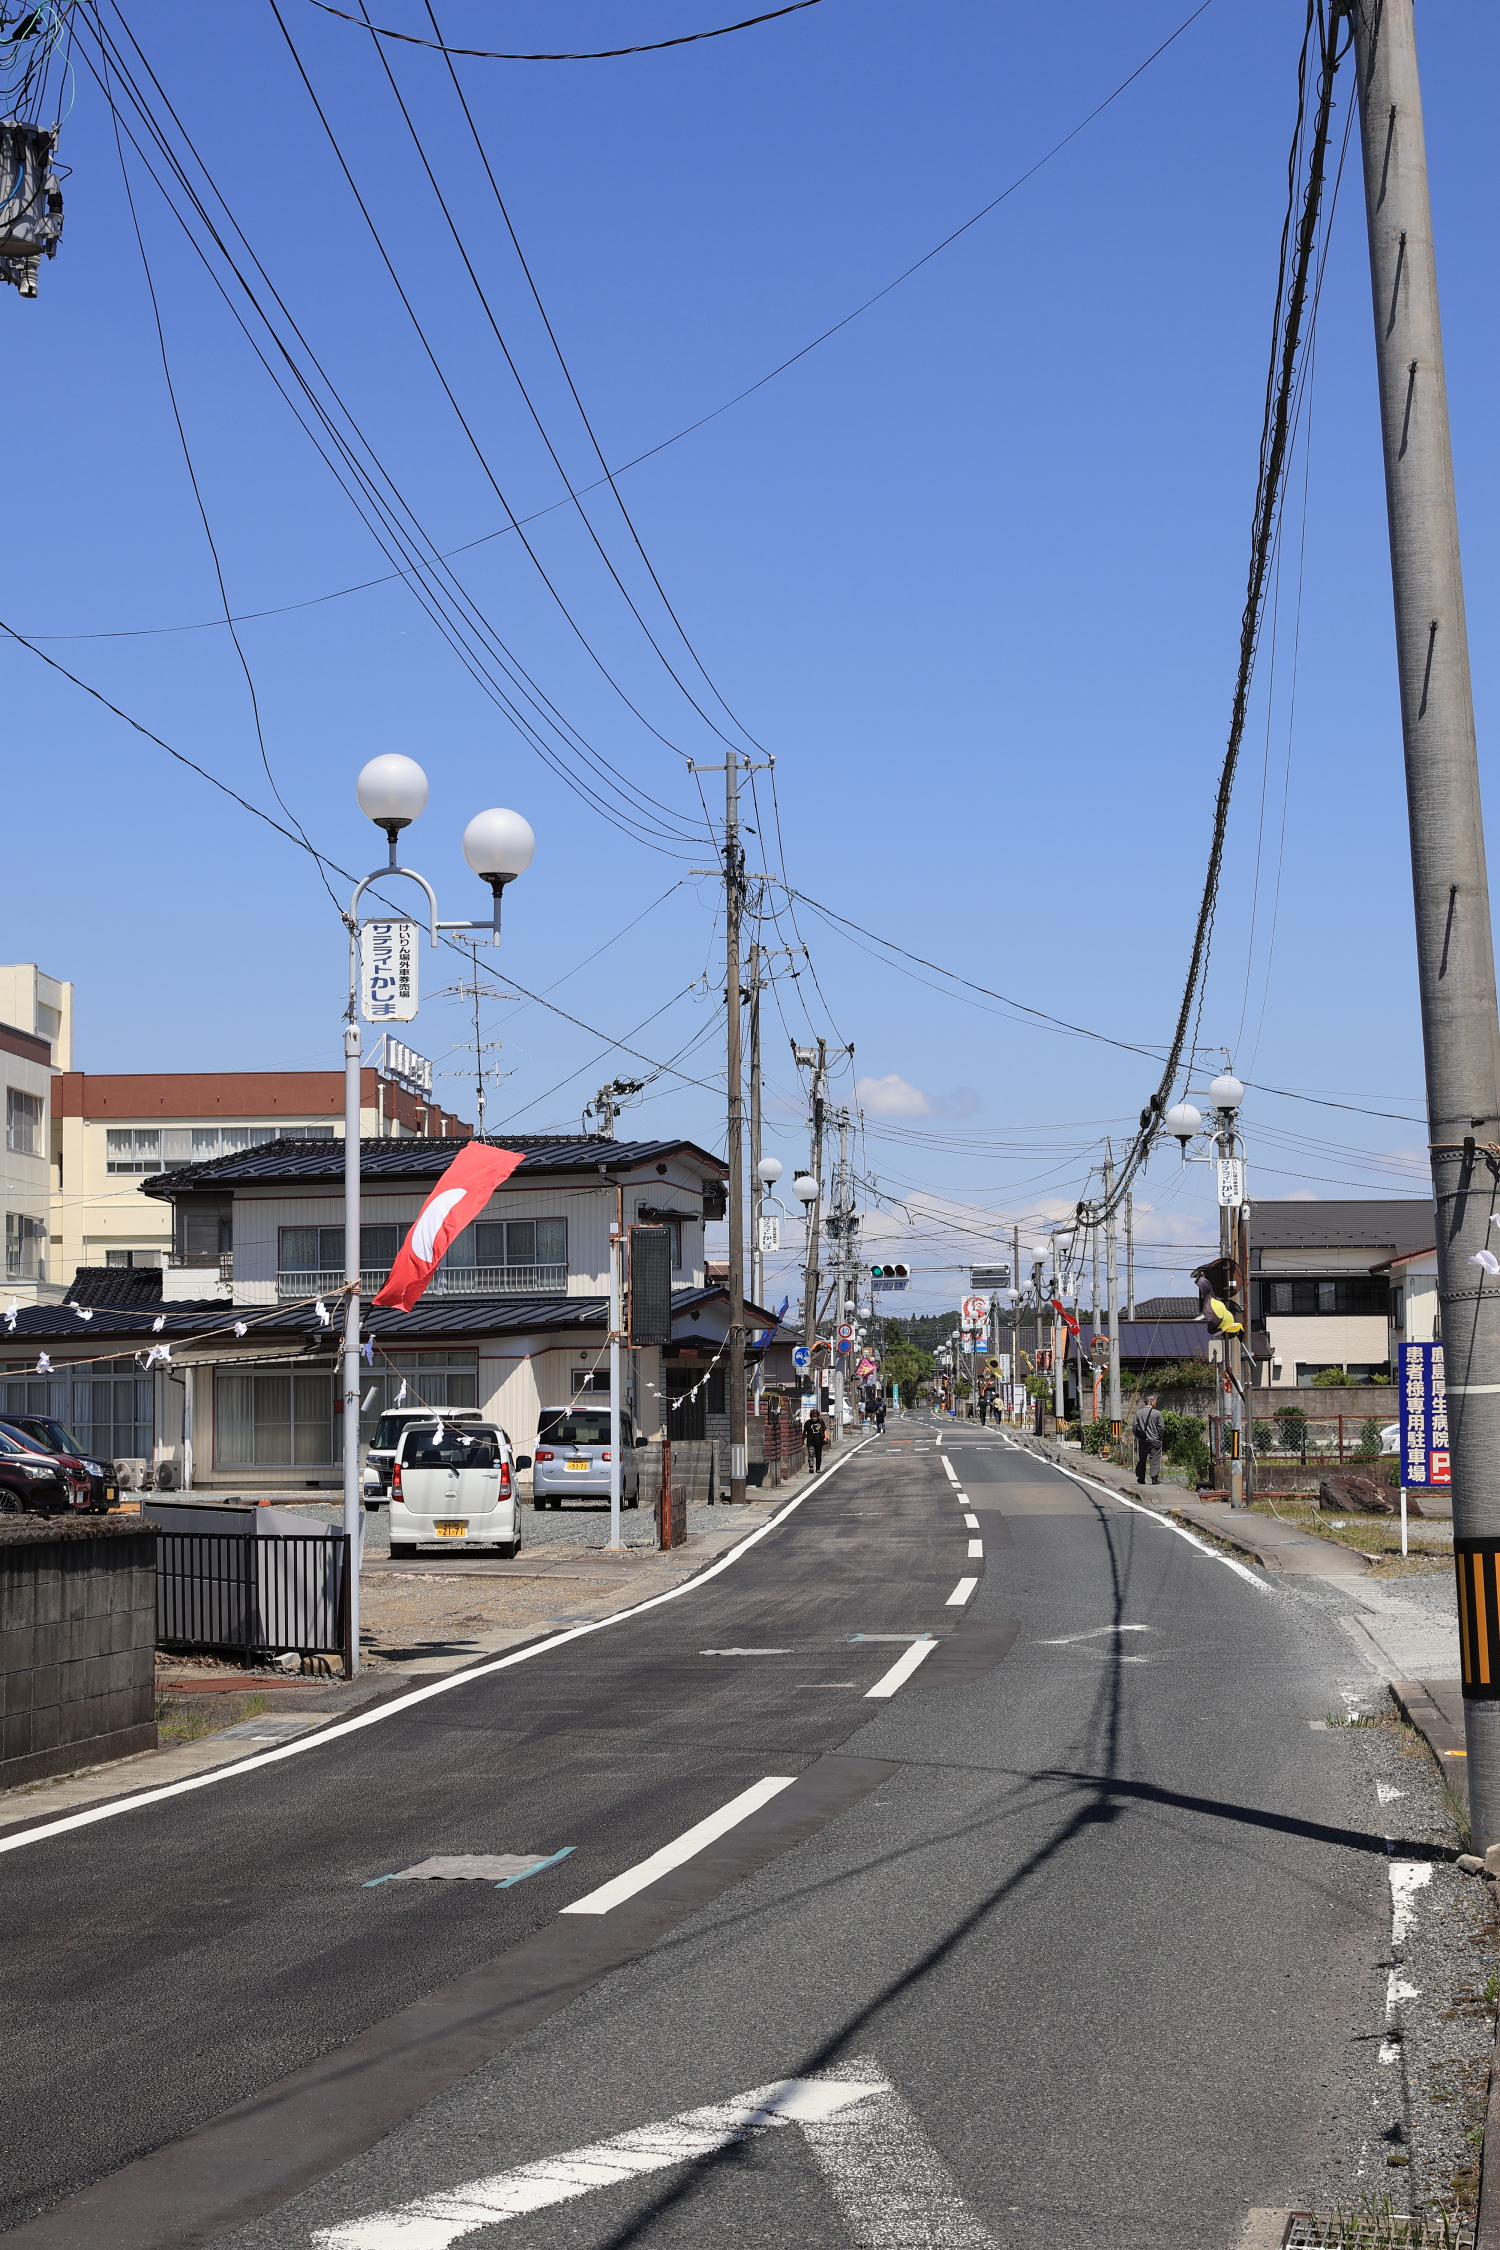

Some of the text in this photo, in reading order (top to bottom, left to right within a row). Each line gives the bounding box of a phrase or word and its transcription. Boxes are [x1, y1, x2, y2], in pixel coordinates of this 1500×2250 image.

[370, 924, 396, 1016] サテライトかしま
[399, 924, 410, 998] けいりん場外車券売場
[841, 1327, 850, 1335] 40
[1406, 1345, 1427, 1483] 患者様専用駐車場
[1432, 1452, 1451, 1474] P
